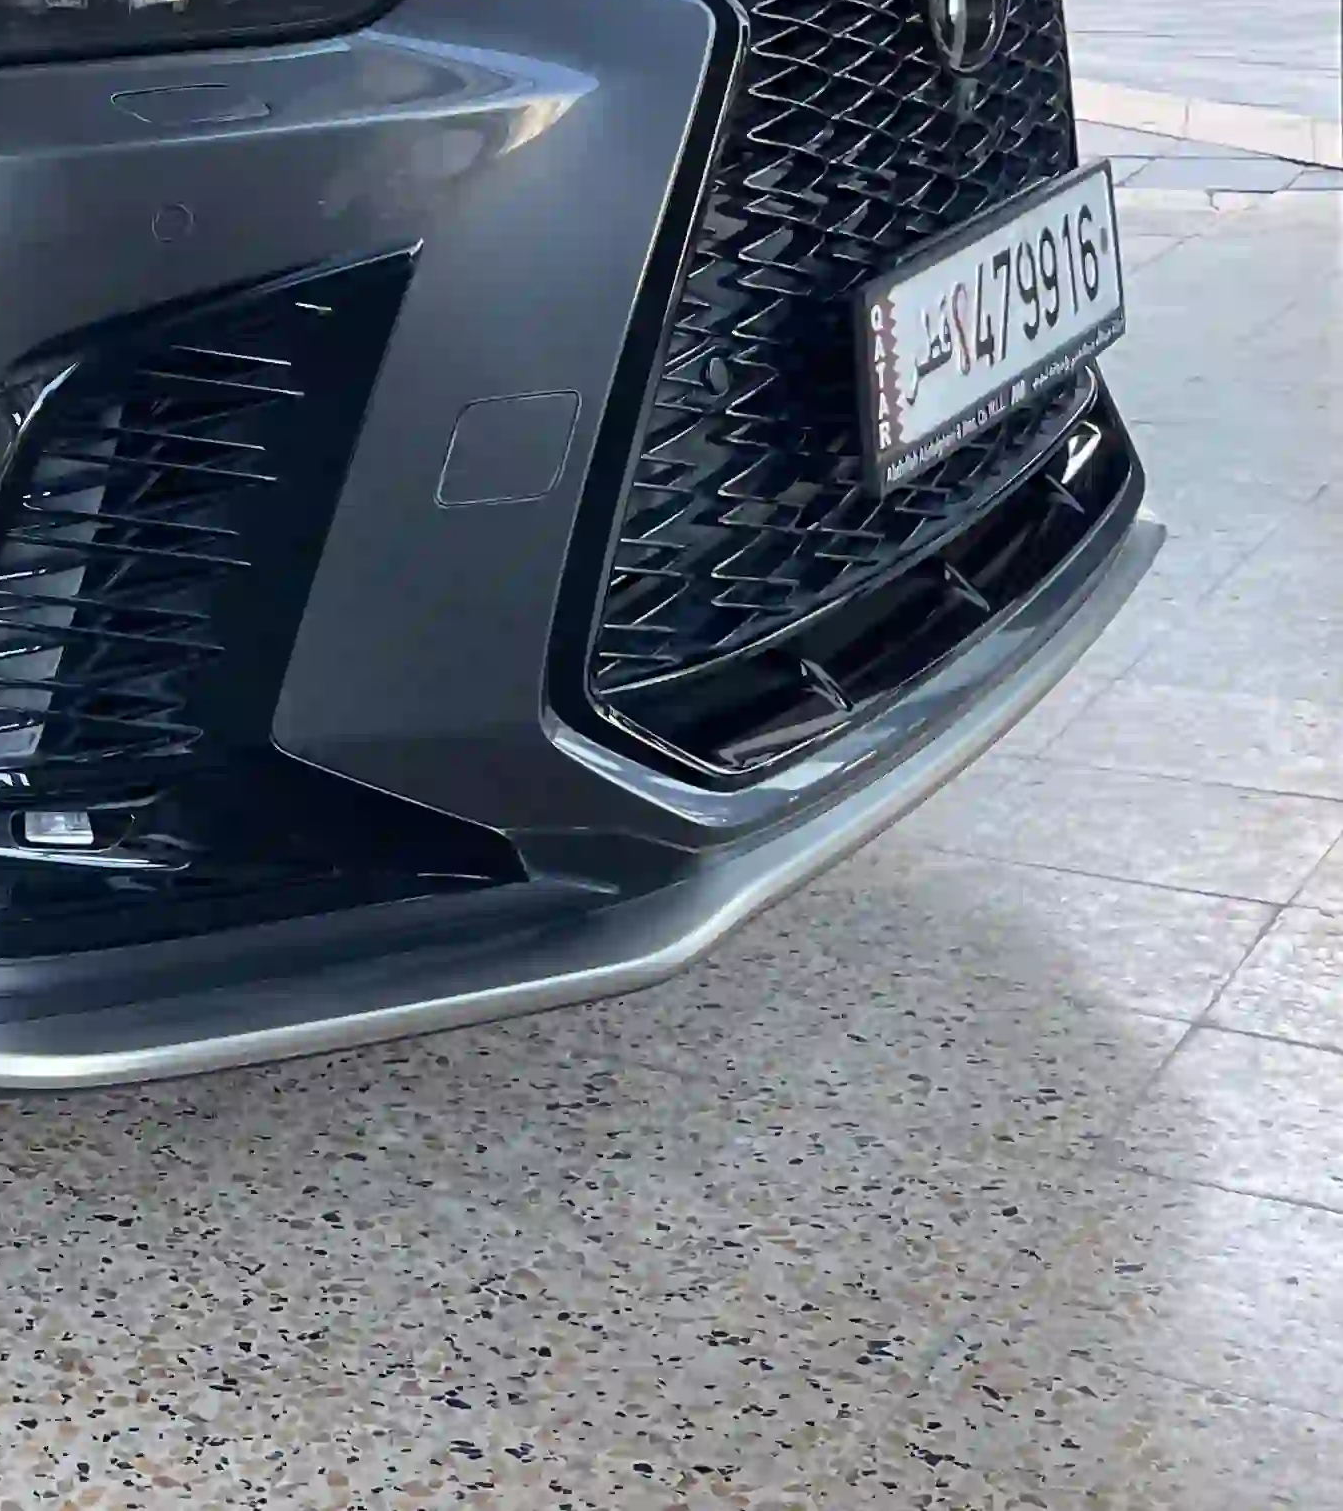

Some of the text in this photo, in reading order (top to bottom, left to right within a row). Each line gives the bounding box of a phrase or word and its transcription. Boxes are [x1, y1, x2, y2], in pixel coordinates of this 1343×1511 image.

[906, 293, 952, 406] قطر
[975, 204, 1099, 368] 479916
[870, 304, 892, 450] QATAR
